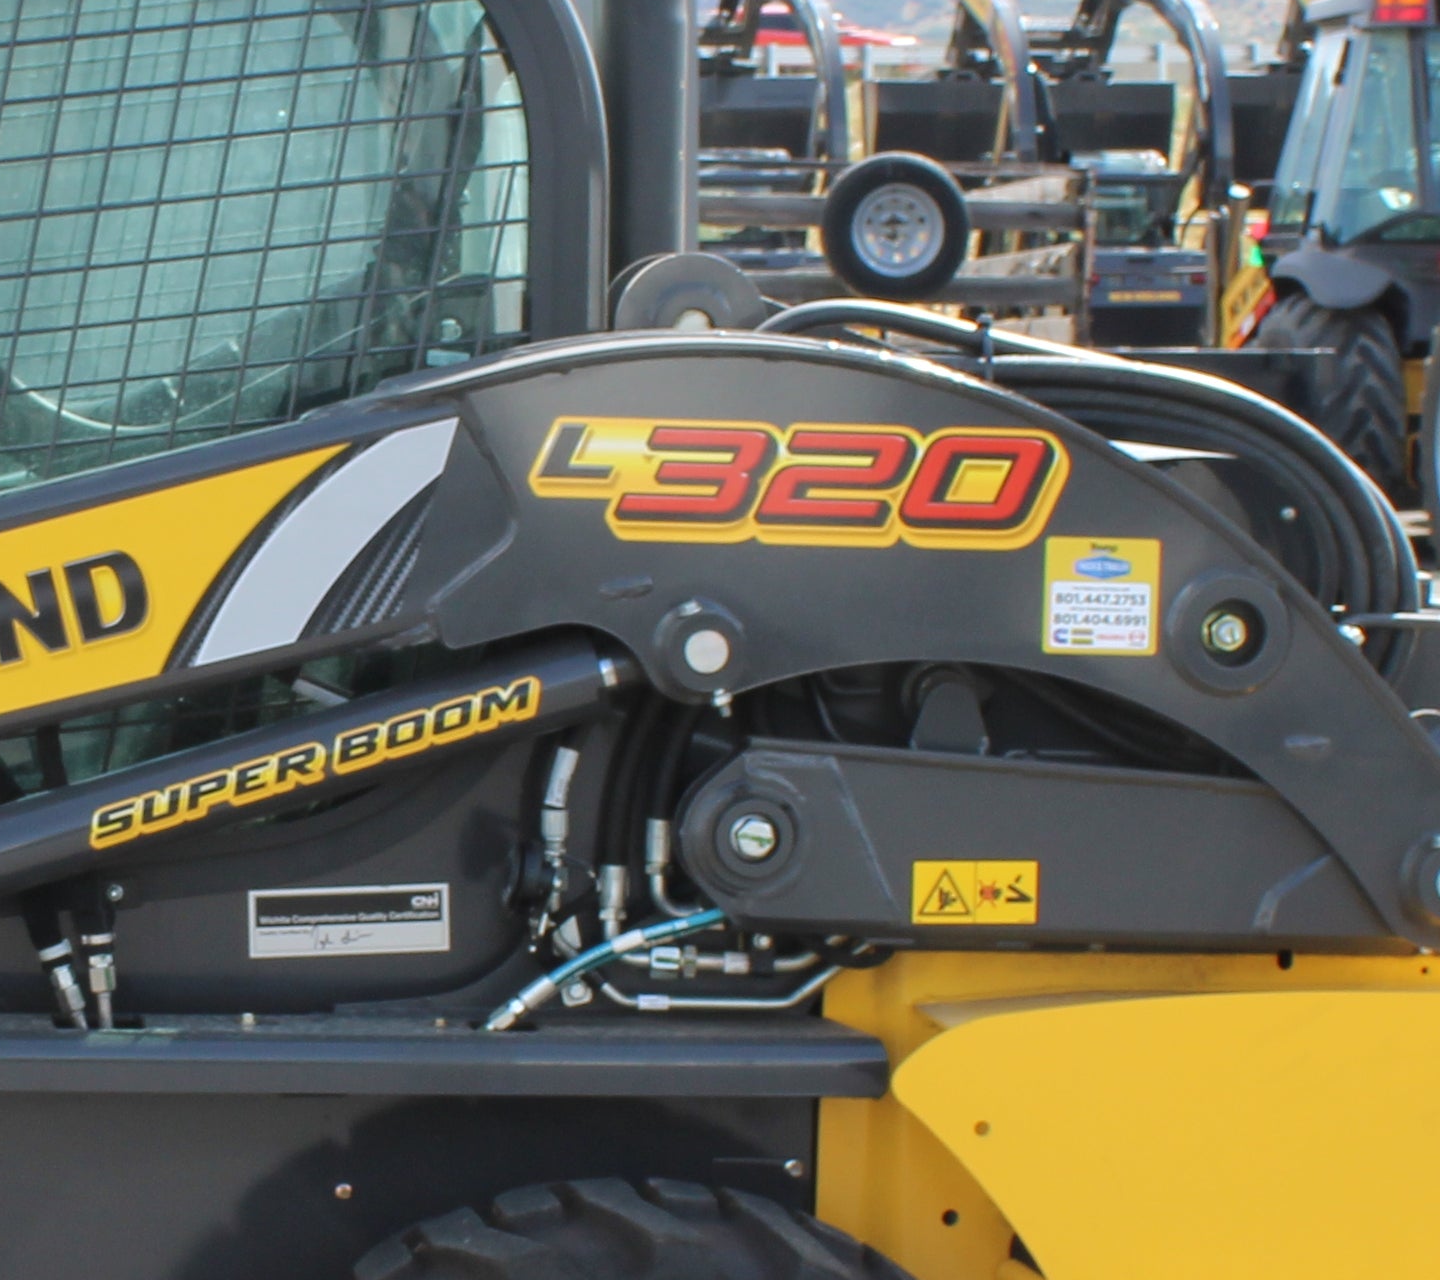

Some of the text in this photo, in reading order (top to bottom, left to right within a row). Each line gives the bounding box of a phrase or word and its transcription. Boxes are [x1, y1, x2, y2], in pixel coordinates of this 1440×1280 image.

[531, 418, 1066, 542] L320
[93, 679, 537, 845] SUPER BOOM
